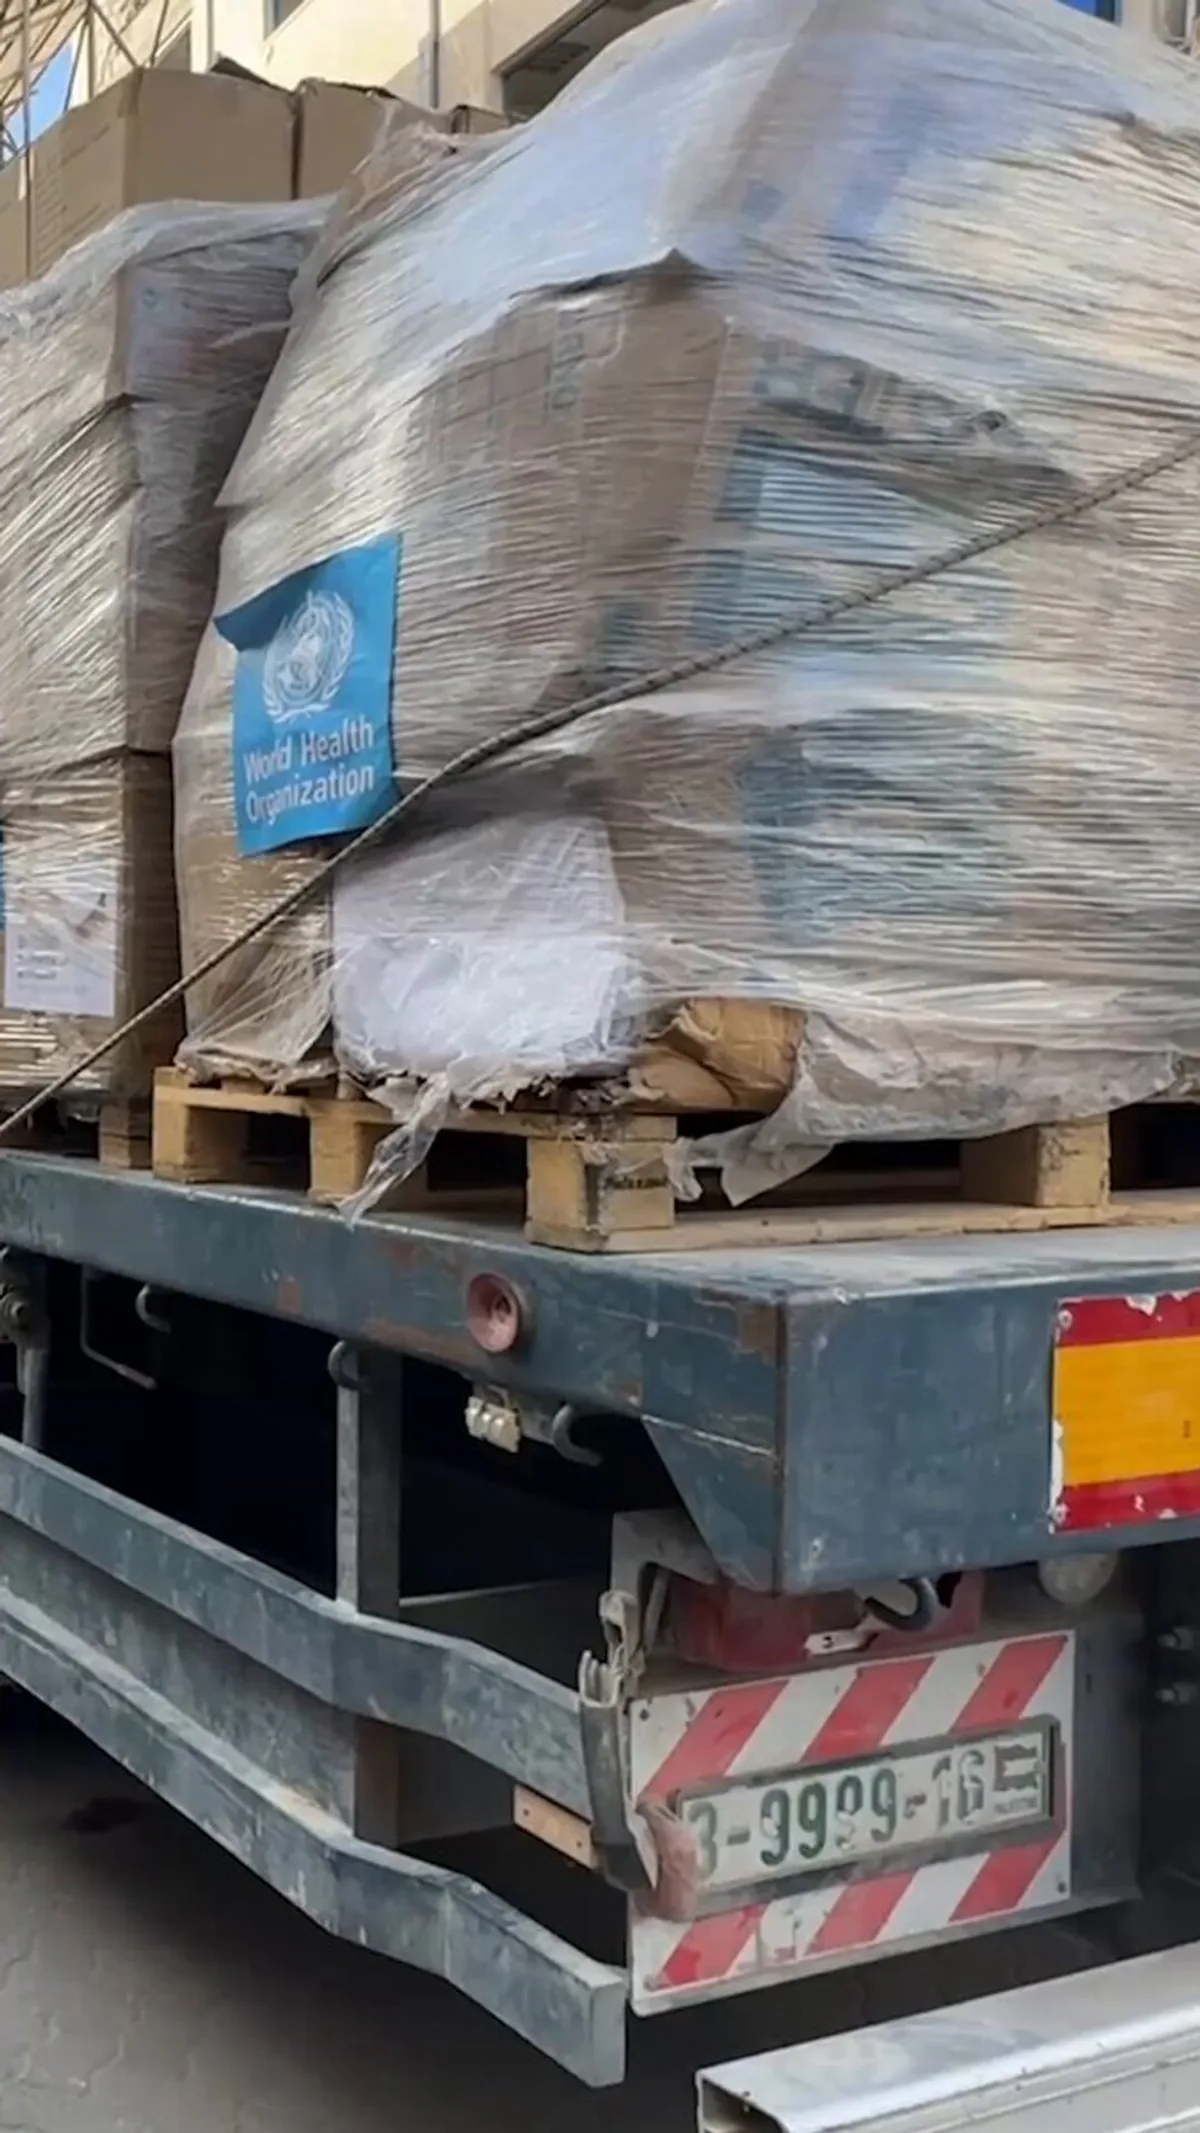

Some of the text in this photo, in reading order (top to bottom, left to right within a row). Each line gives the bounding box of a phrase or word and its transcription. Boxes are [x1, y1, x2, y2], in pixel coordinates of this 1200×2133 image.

[243, 714, 373, 785] World Health
[246, 763, 374, 825] Organization
